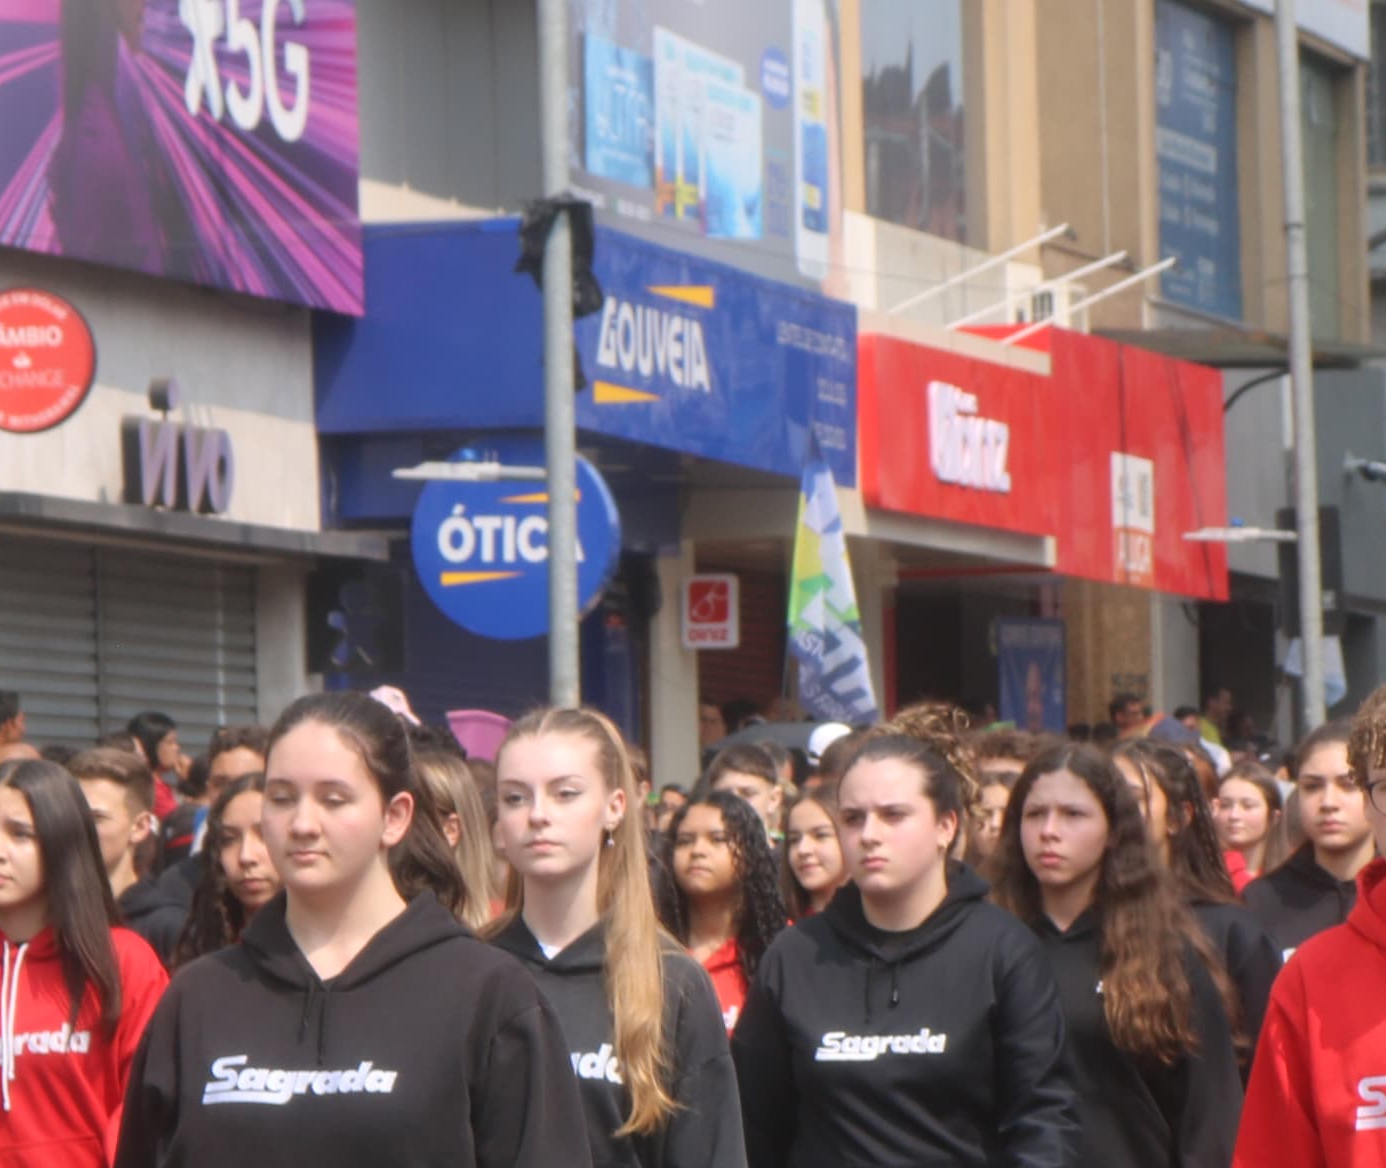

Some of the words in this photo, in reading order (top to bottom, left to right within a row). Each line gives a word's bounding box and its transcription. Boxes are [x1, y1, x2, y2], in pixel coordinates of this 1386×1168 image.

[597, 296, 711, 393] GOUVEIA
[123, 376, 234, 514] vivo
[437, 503, 585, 563] ÓTIC
[815, 1028, 946, 1061] Sagrada
[202, 1055, 397, 1105] Sagrada
